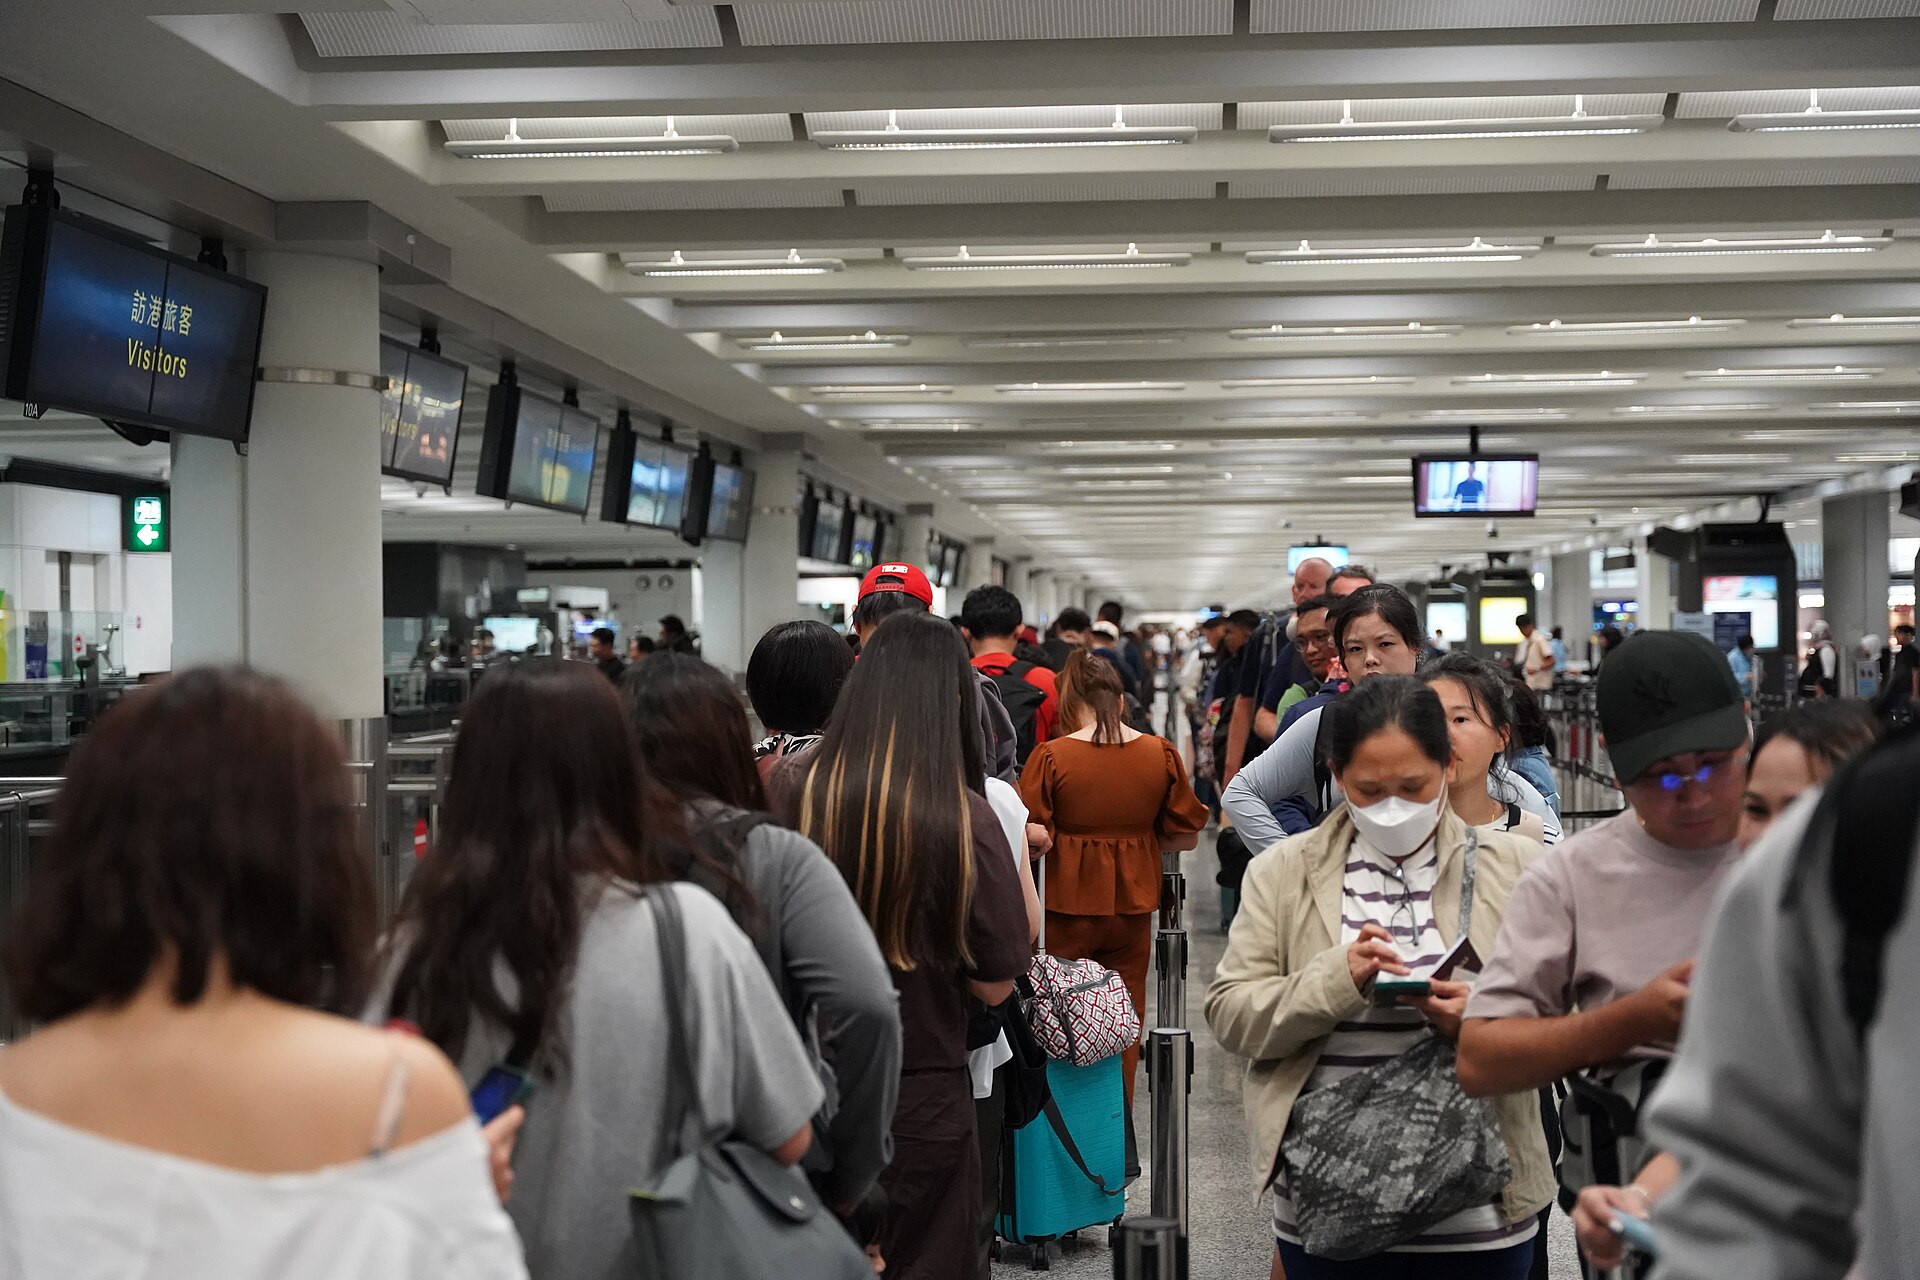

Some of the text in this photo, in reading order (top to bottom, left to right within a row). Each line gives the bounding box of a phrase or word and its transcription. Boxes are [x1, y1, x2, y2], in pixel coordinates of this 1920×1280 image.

[131, 289, 193, 337] 訪港旅客
[128, 337, 187, 378] Visitors
[25, 402, 38, 418] 10A
